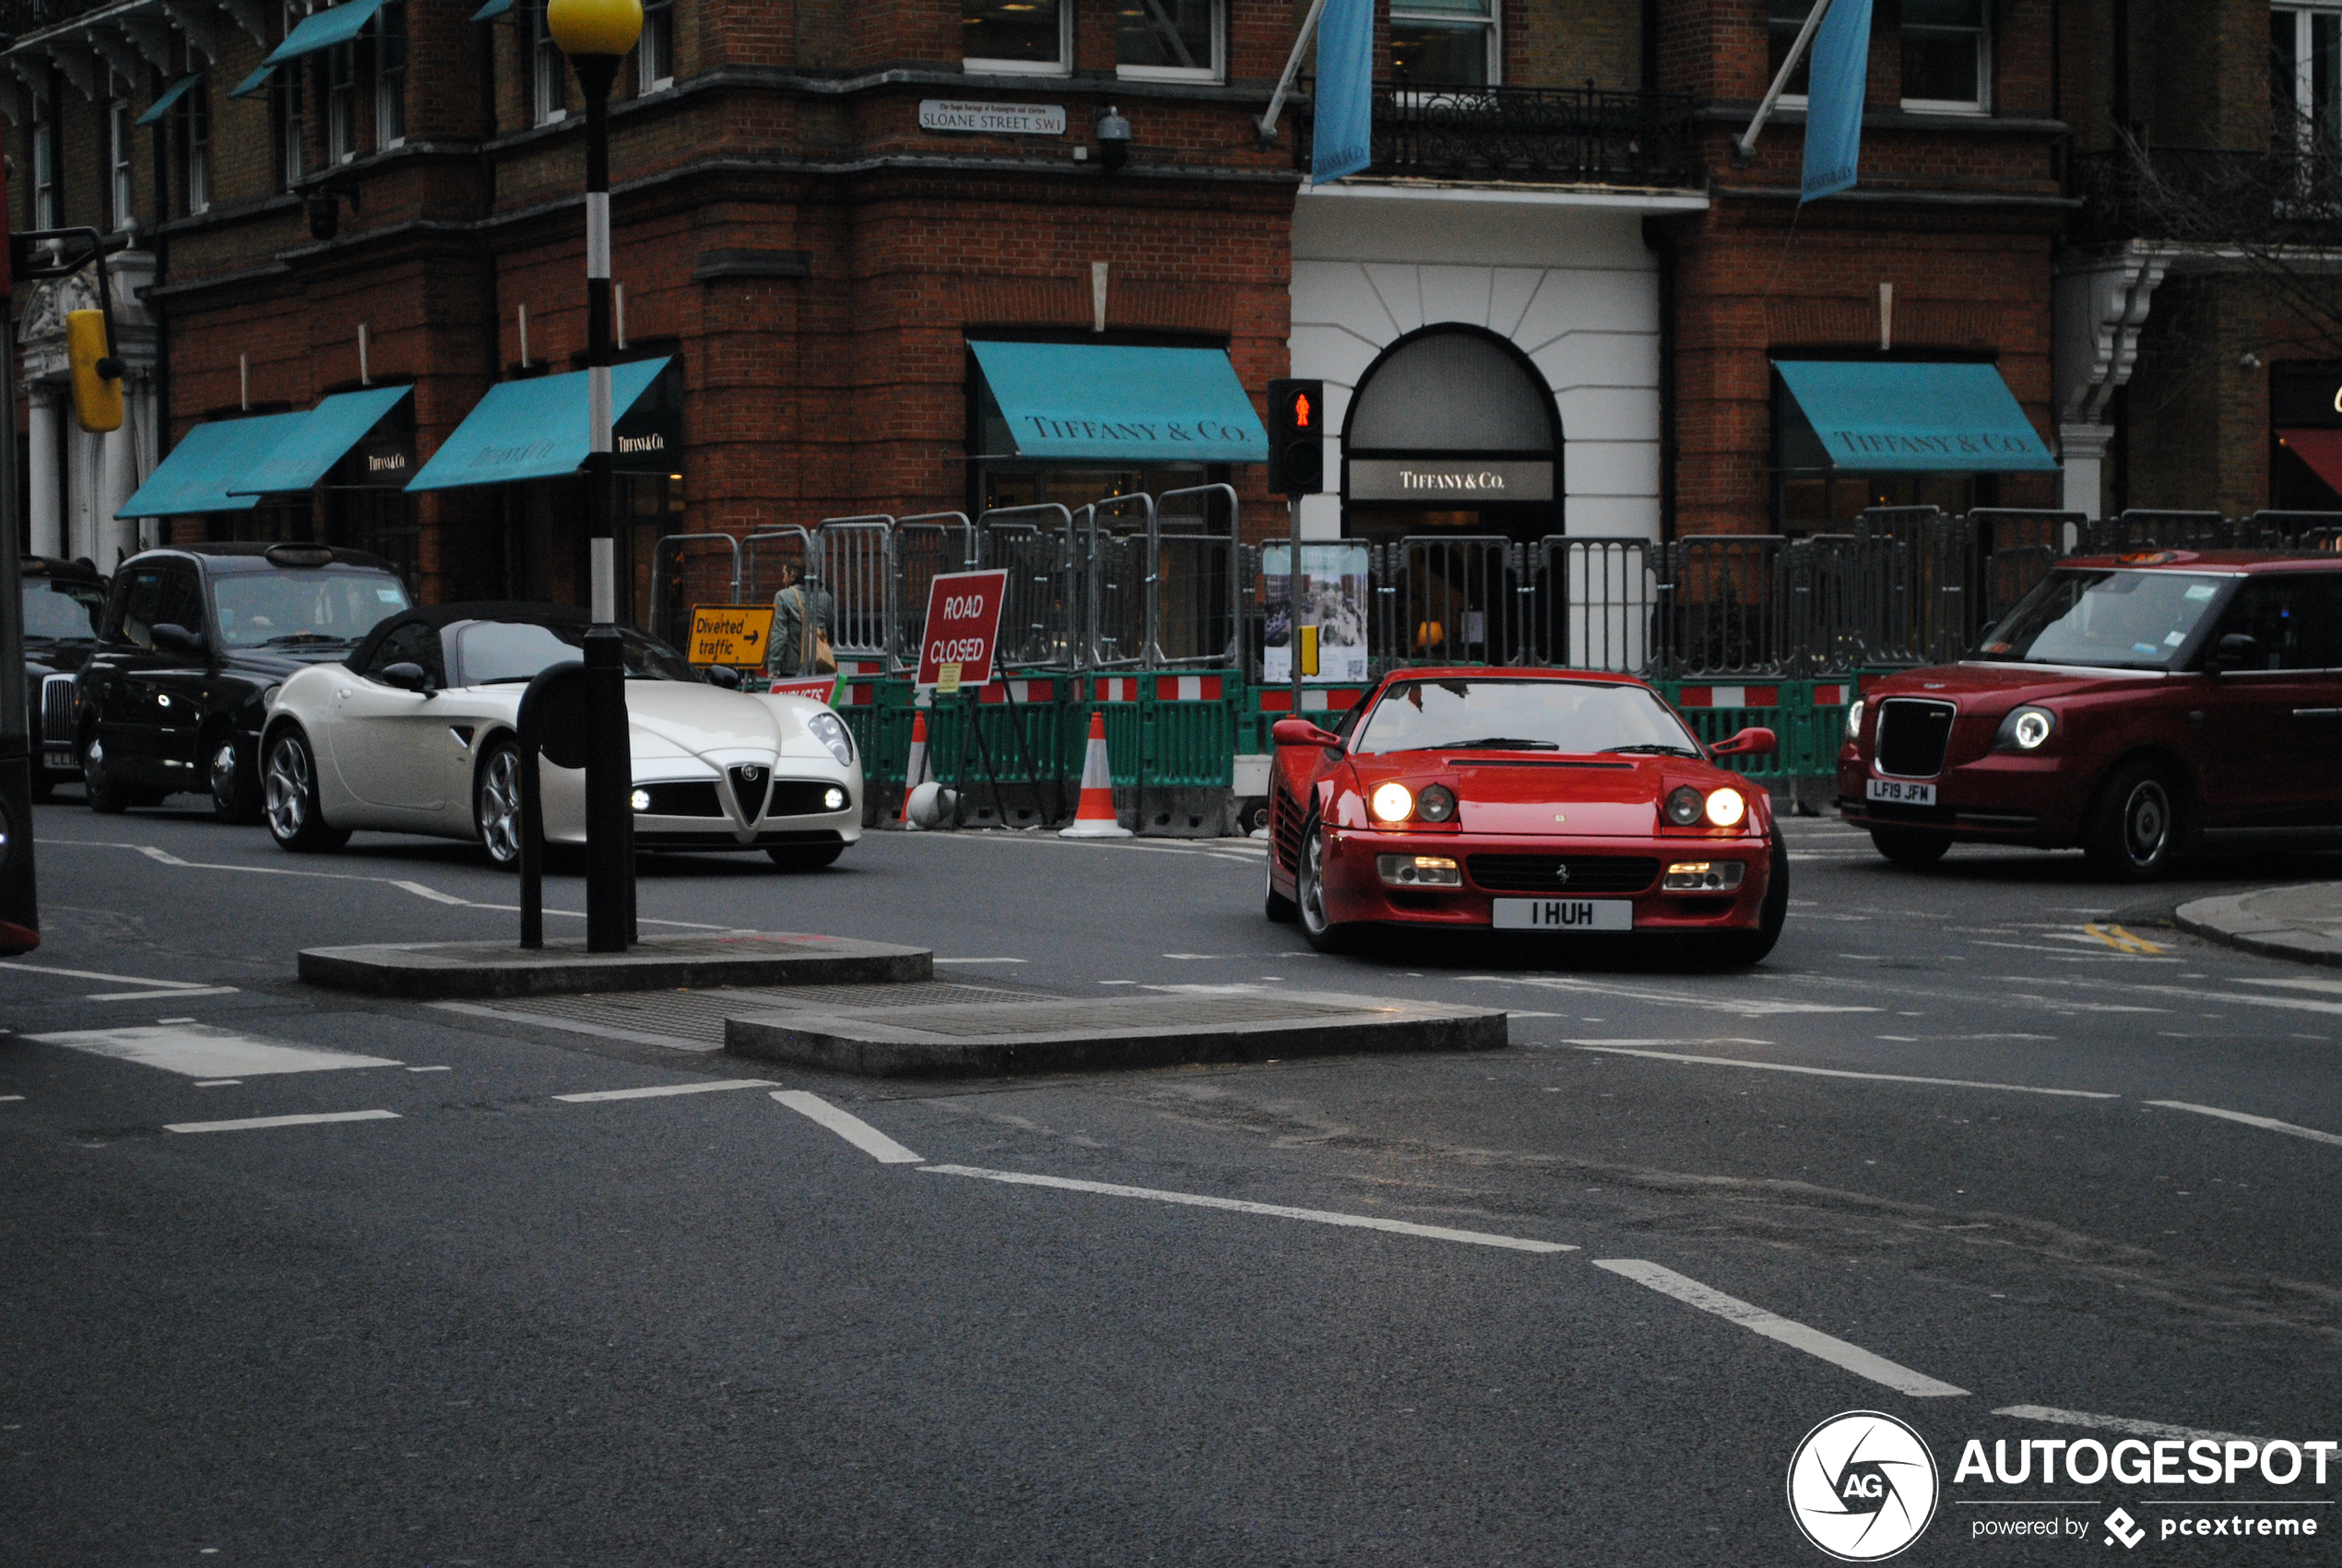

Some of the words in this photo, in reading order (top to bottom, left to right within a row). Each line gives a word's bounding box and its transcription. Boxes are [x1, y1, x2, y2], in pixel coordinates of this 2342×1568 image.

[923, 112, 975, 127] SLOANE
[1025, 416, 1158, 442] TIFFANY
[1167, 420, 1192, 441] &
[1197, 420, 1251, 442] CO.
[1834, 431, 1951, 453] TIFFANY
[1958, 435, 1980, 453] &
[943, 595, 984, 619] ROAD
[696, 617, 744, 634] Diverted
[699, 639, 734, 656] traffic
[929, 638, 985, 664] CLOSED
[1874, 781, 1901, 798] LF19
[1545, 902, 1592, 925] HUH
